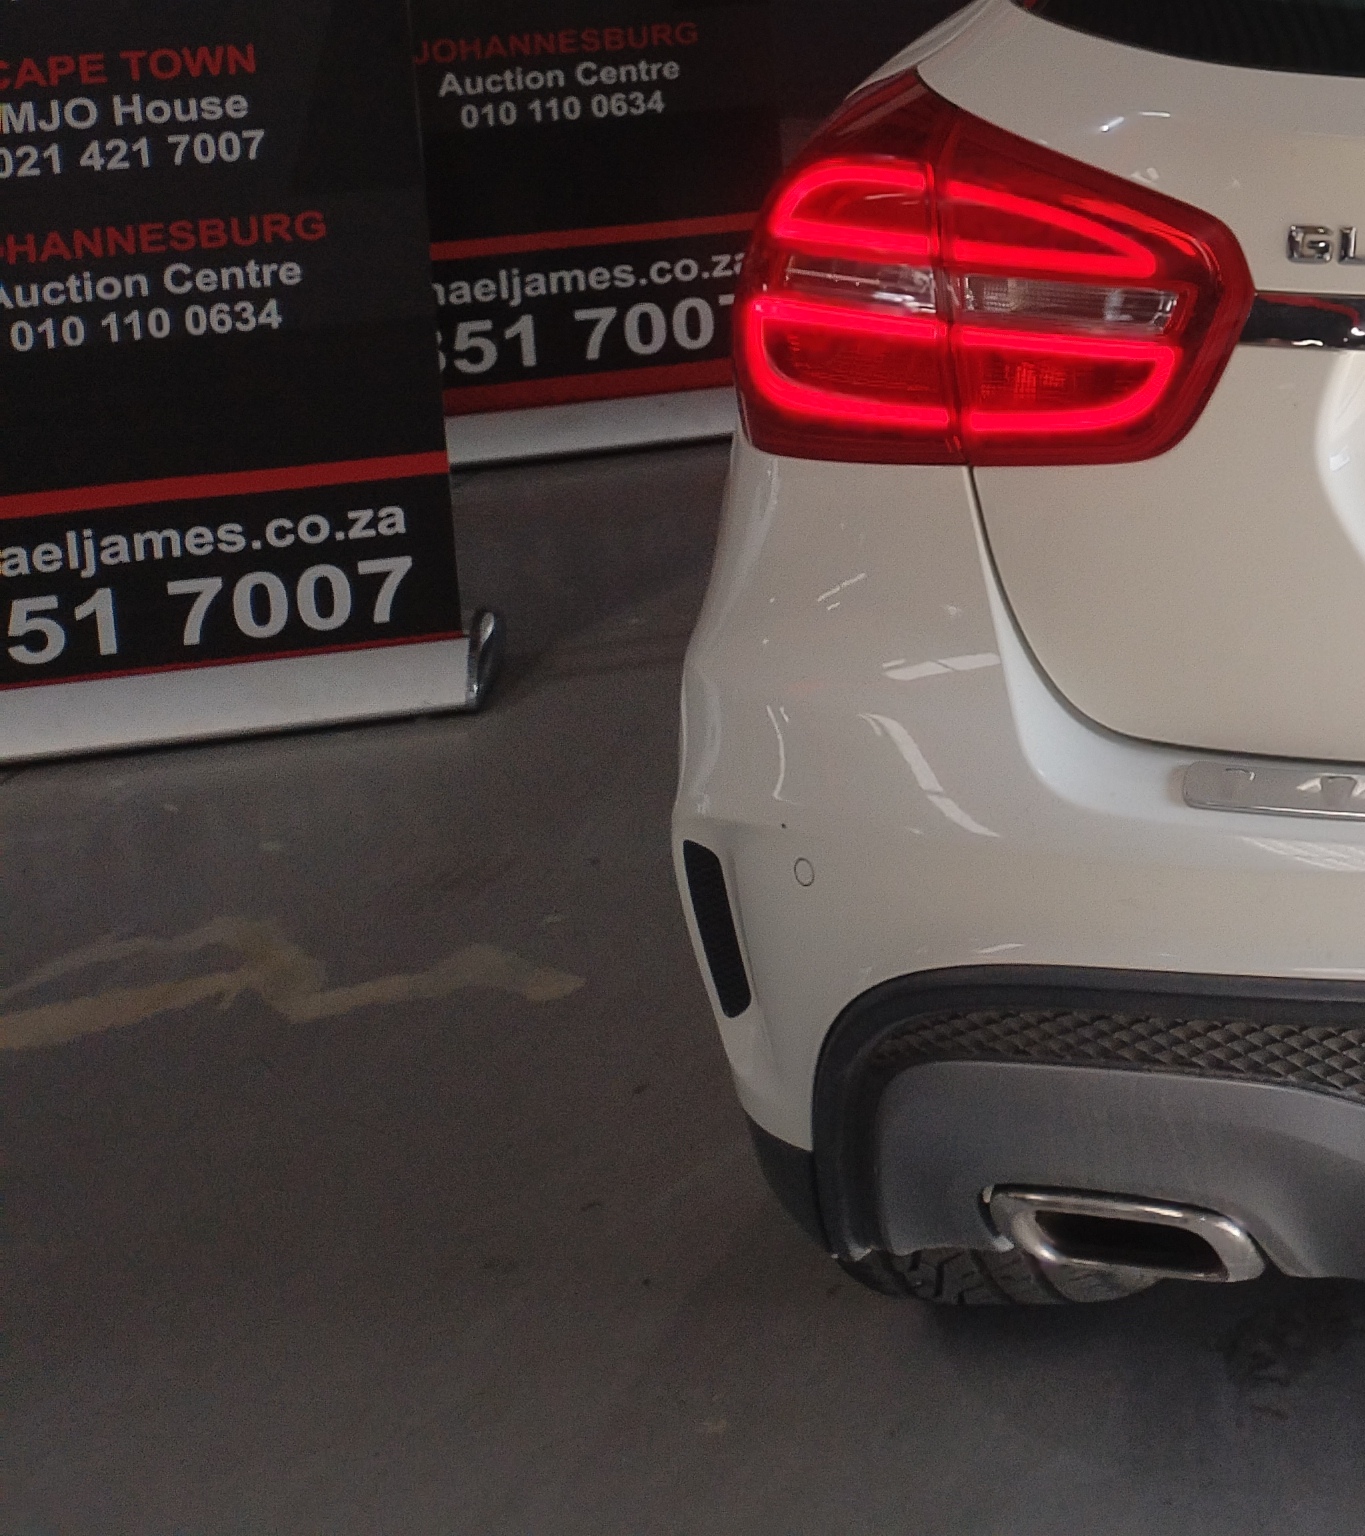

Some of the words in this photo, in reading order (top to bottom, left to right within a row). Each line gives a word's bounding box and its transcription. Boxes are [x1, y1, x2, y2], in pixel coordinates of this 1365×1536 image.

[120, 44, 257, 81] TOWN
[412, 21, 699, 65] JOHANNESBURG
[438, 67, 566, 97] Auction
[575, 60, 681, 86] Centre
[1, 96, 98, 134] MJO
[113, 93, 249, 126] House
[460, 101, 518, 129] 010
[528, 96, 582, 122] 110
[591, 90, 666, 118] 0634
[80, 136, 151, 171] 421
[167, 129, 266, 166] 7007
[0, 210, 326, 265] HANNESBURG
[164, 259, 303, 295] Centre
[10, 315, 85, 352] 010
[101, 307, 170, 343] 110
[184, 298, 283, 337] 0634
[437, 314, 537, 375] 51
[7, 586, 119, 666] 51
[167, 556, 414, 647] 7007
